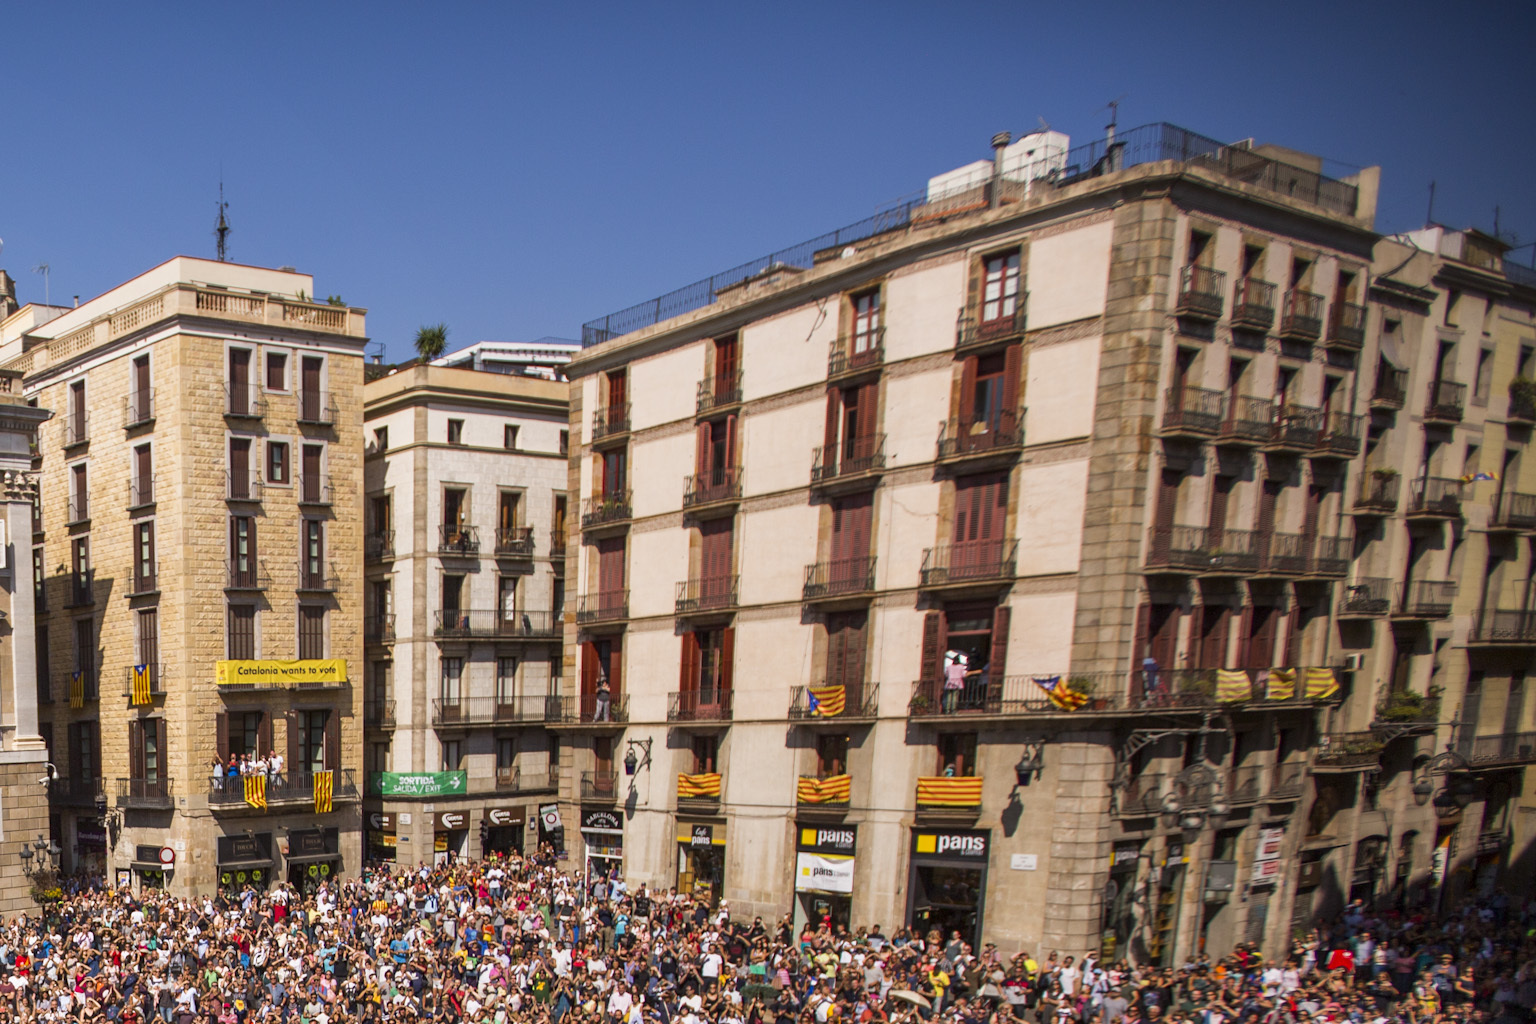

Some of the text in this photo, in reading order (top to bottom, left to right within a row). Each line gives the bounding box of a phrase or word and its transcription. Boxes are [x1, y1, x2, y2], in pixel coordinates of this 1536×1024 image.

[238, 666, 278, 675] Catalonia
[281, 667, 306, 675] wants
[320, 666, 337, 674] vote
[399, 776, 435, 785] SORTIDA
[393, 784, 417, 793] SALIDA
[425, 784, 442, 793] EXIT
[586, 812, 619, 827] BARCELONA
[691, 836, 710, 846] pans
[817, 830, 854, 846] pans
[937, 835, 985, 853] pans
[813, 867, 834, 877] pans
